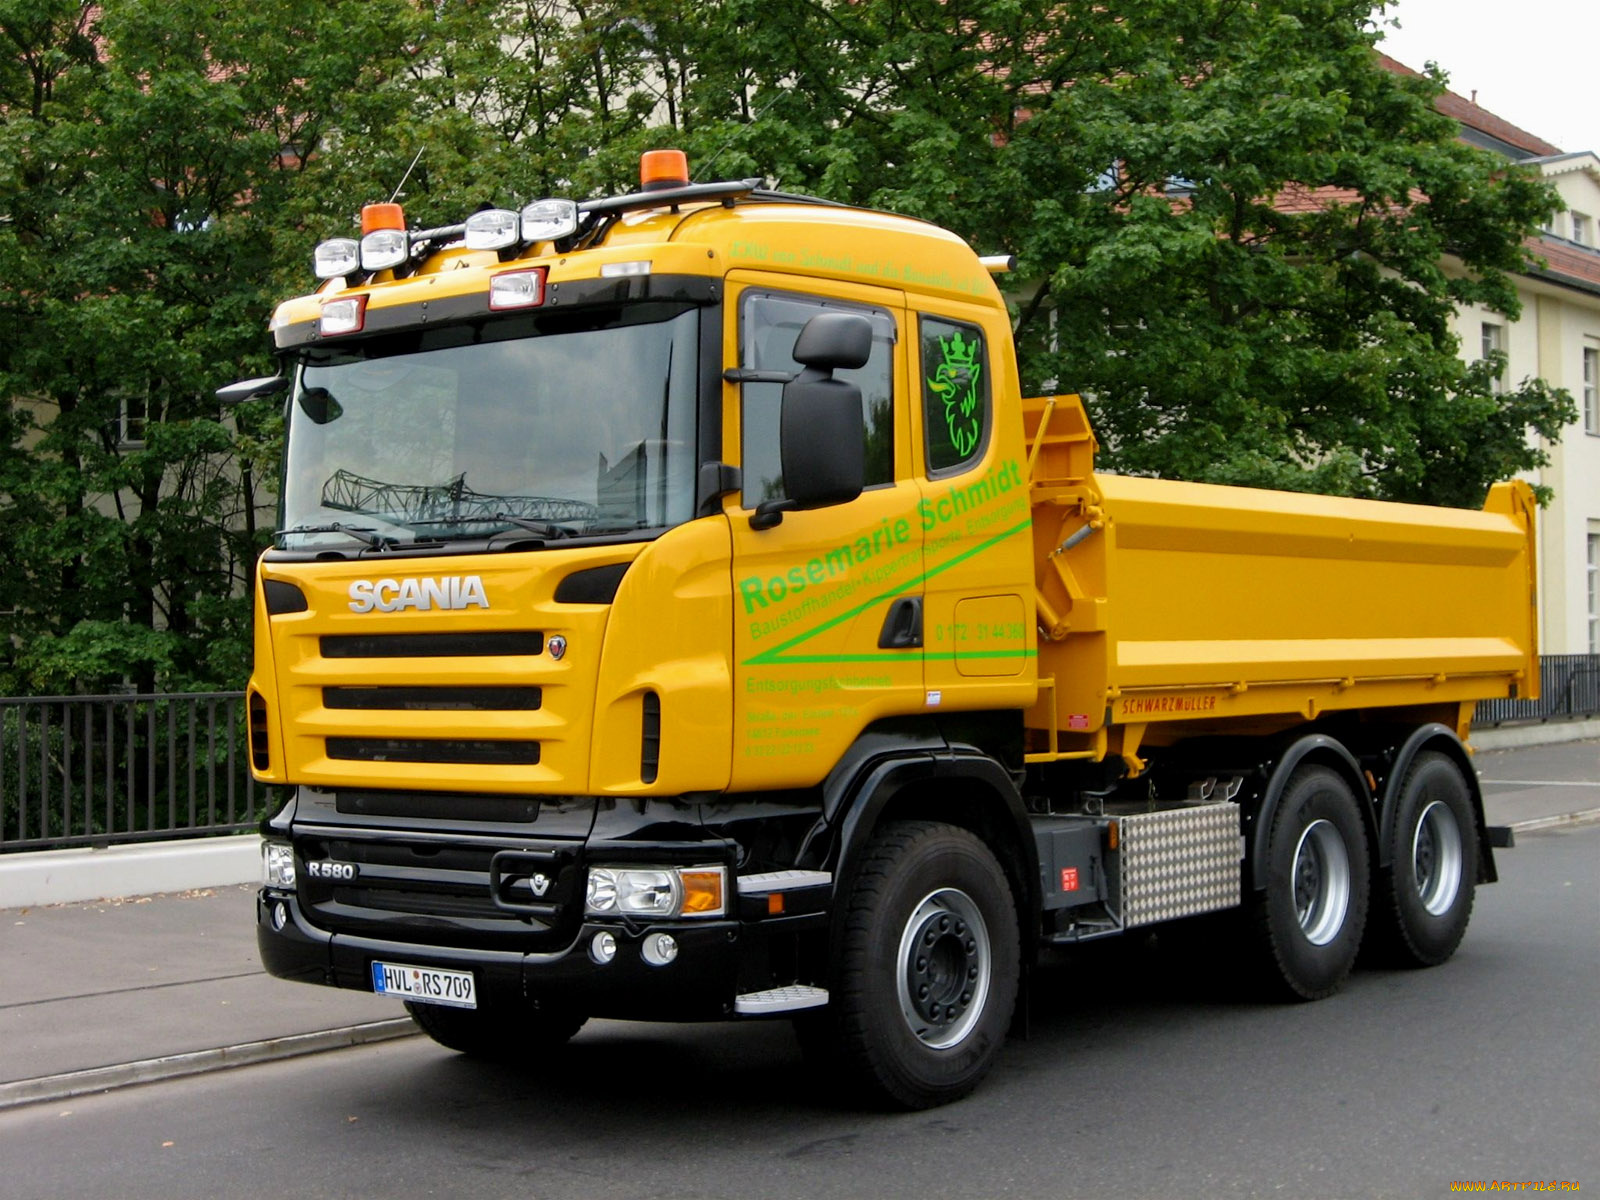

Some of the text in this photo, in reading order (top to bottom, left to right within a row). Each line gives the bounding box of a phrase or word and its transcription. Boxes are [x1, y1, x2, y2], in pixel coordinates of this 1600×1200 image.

[740, 459, 1022, 614] Rosemarie Schmidt
[348, 575, 490, 613] SCANIA
[384, 967, 412, 992] HVL
